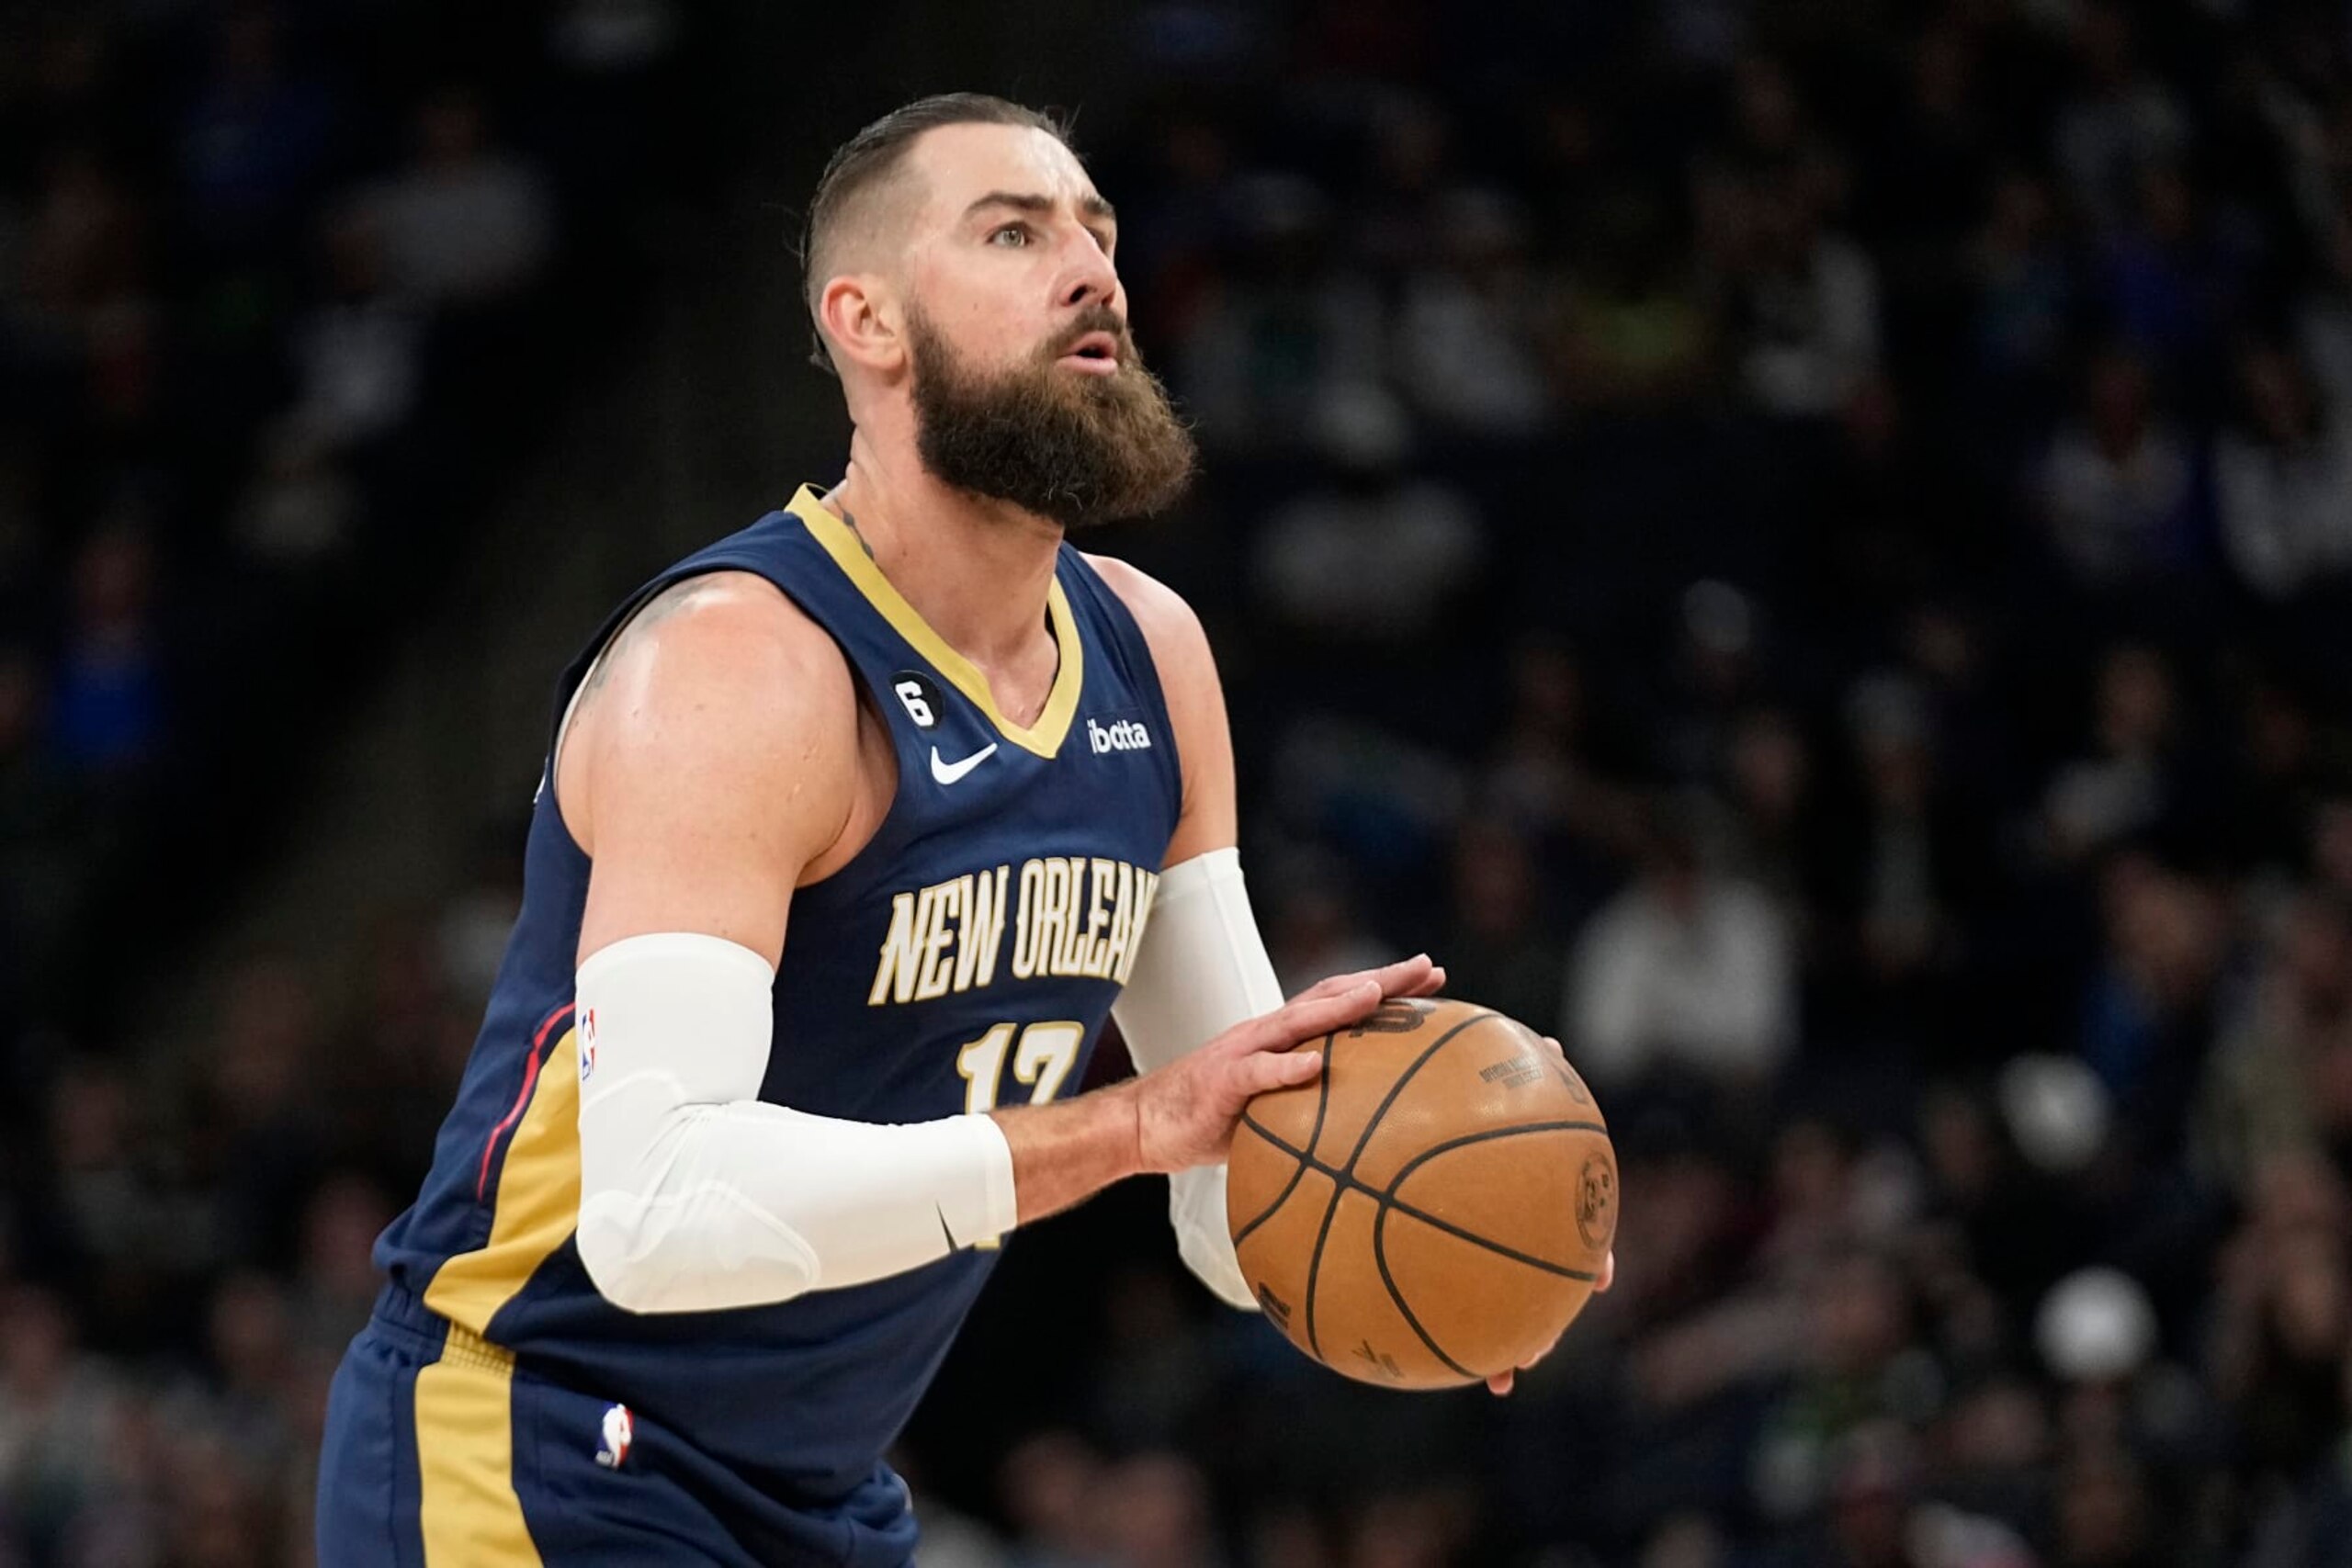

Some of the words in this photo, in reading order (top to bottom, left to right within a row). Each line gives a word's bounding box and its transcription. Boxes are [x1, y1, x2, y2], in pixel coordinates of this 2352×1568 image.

[895, 681, 934, 727] 6
[1087, 718, 1151, 754] ibotta
[868, 865, 1010, 1006] NEW
